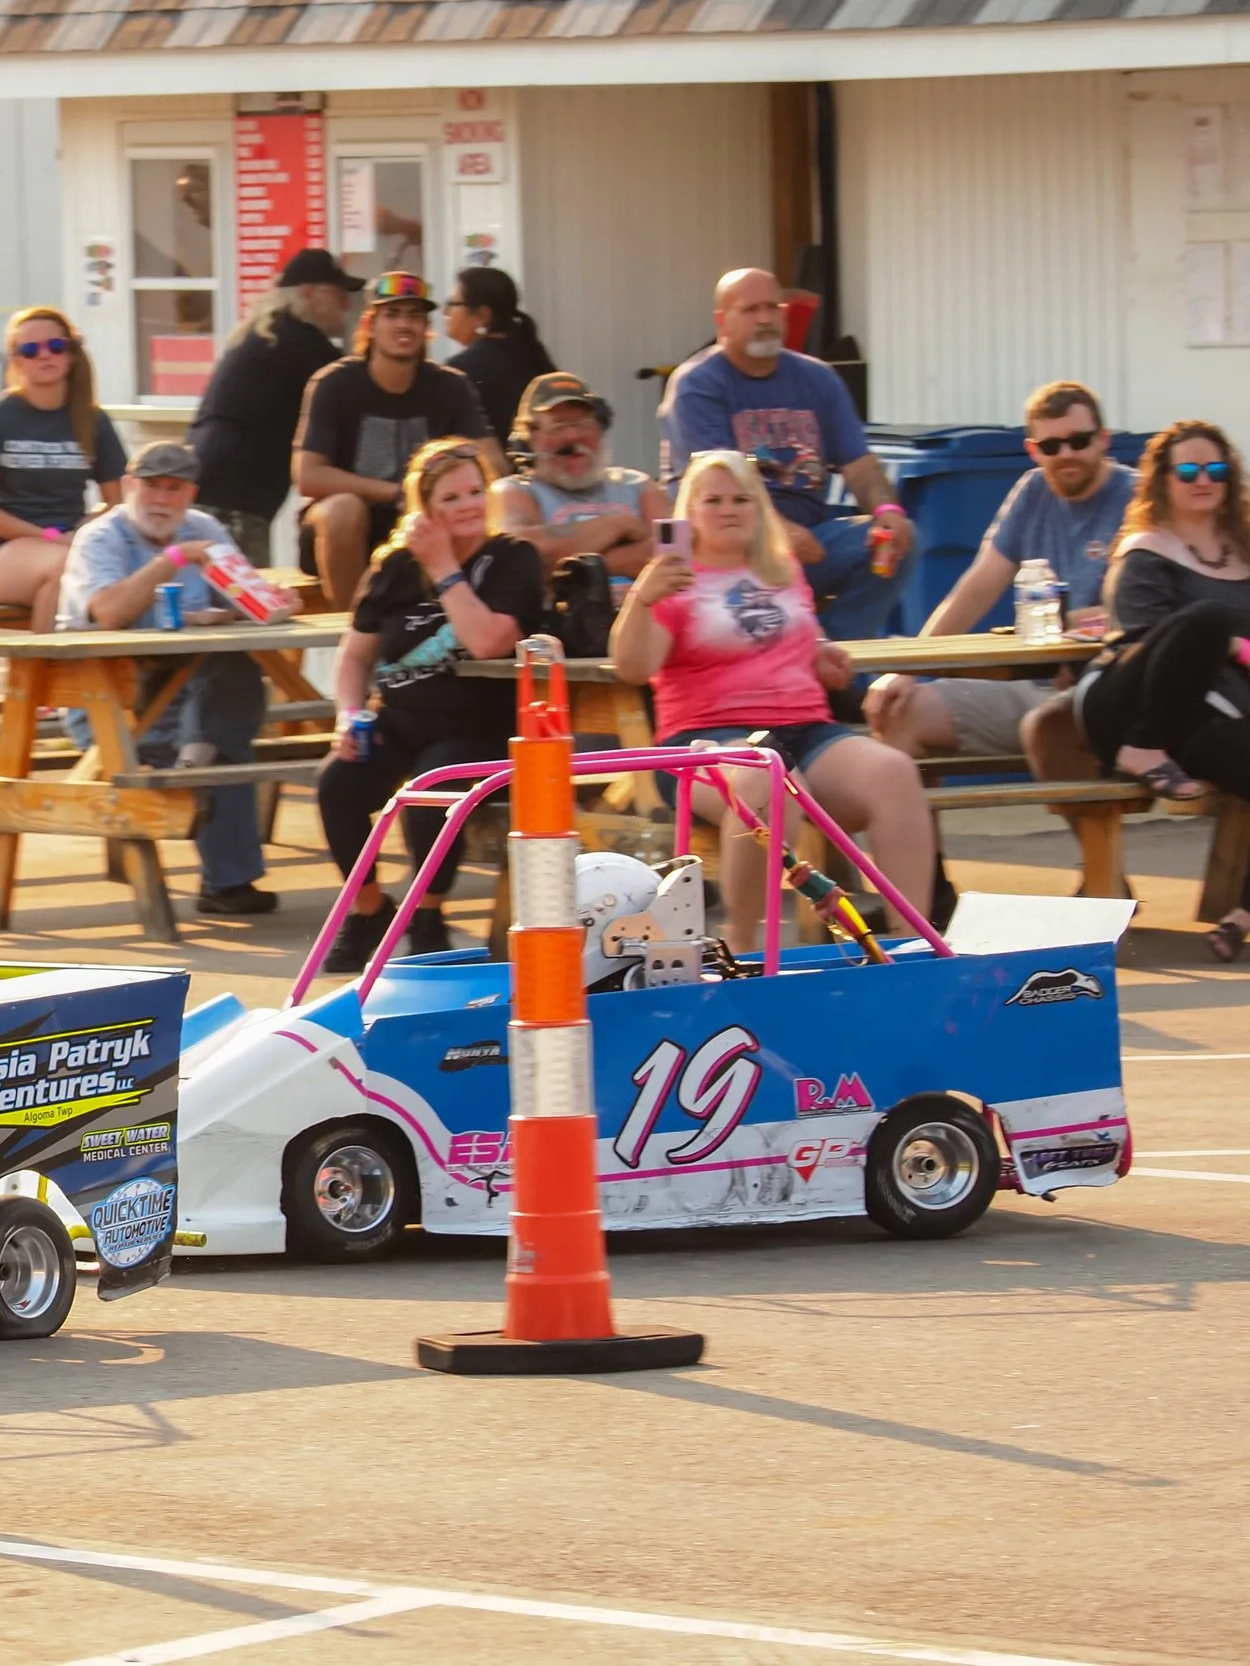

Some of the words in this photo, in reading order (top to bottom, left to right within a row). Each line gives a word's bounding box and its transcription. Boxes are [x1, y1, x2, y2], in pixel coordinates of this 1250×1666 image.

[49, 1029, 152, 1072] Patryk
[116, 1077, 135, 1091] LLC
[614, 1024, 762, 1169] 19
[23, 1109, 55, 1123] Algoma
[57, 1106, 74, 1119] Twp
[82, 1131, 124, 1149] SWEET
[125, 1125, 168, 1143] WATER
[83, 1148, 127, 1162] MEDICAL
[129, 1142, 168, 1156] CENTER
[93, 1188, 174, 1229] QUICKTIME
[104, 1216, 168, 1245] AUTOMOTIVE
